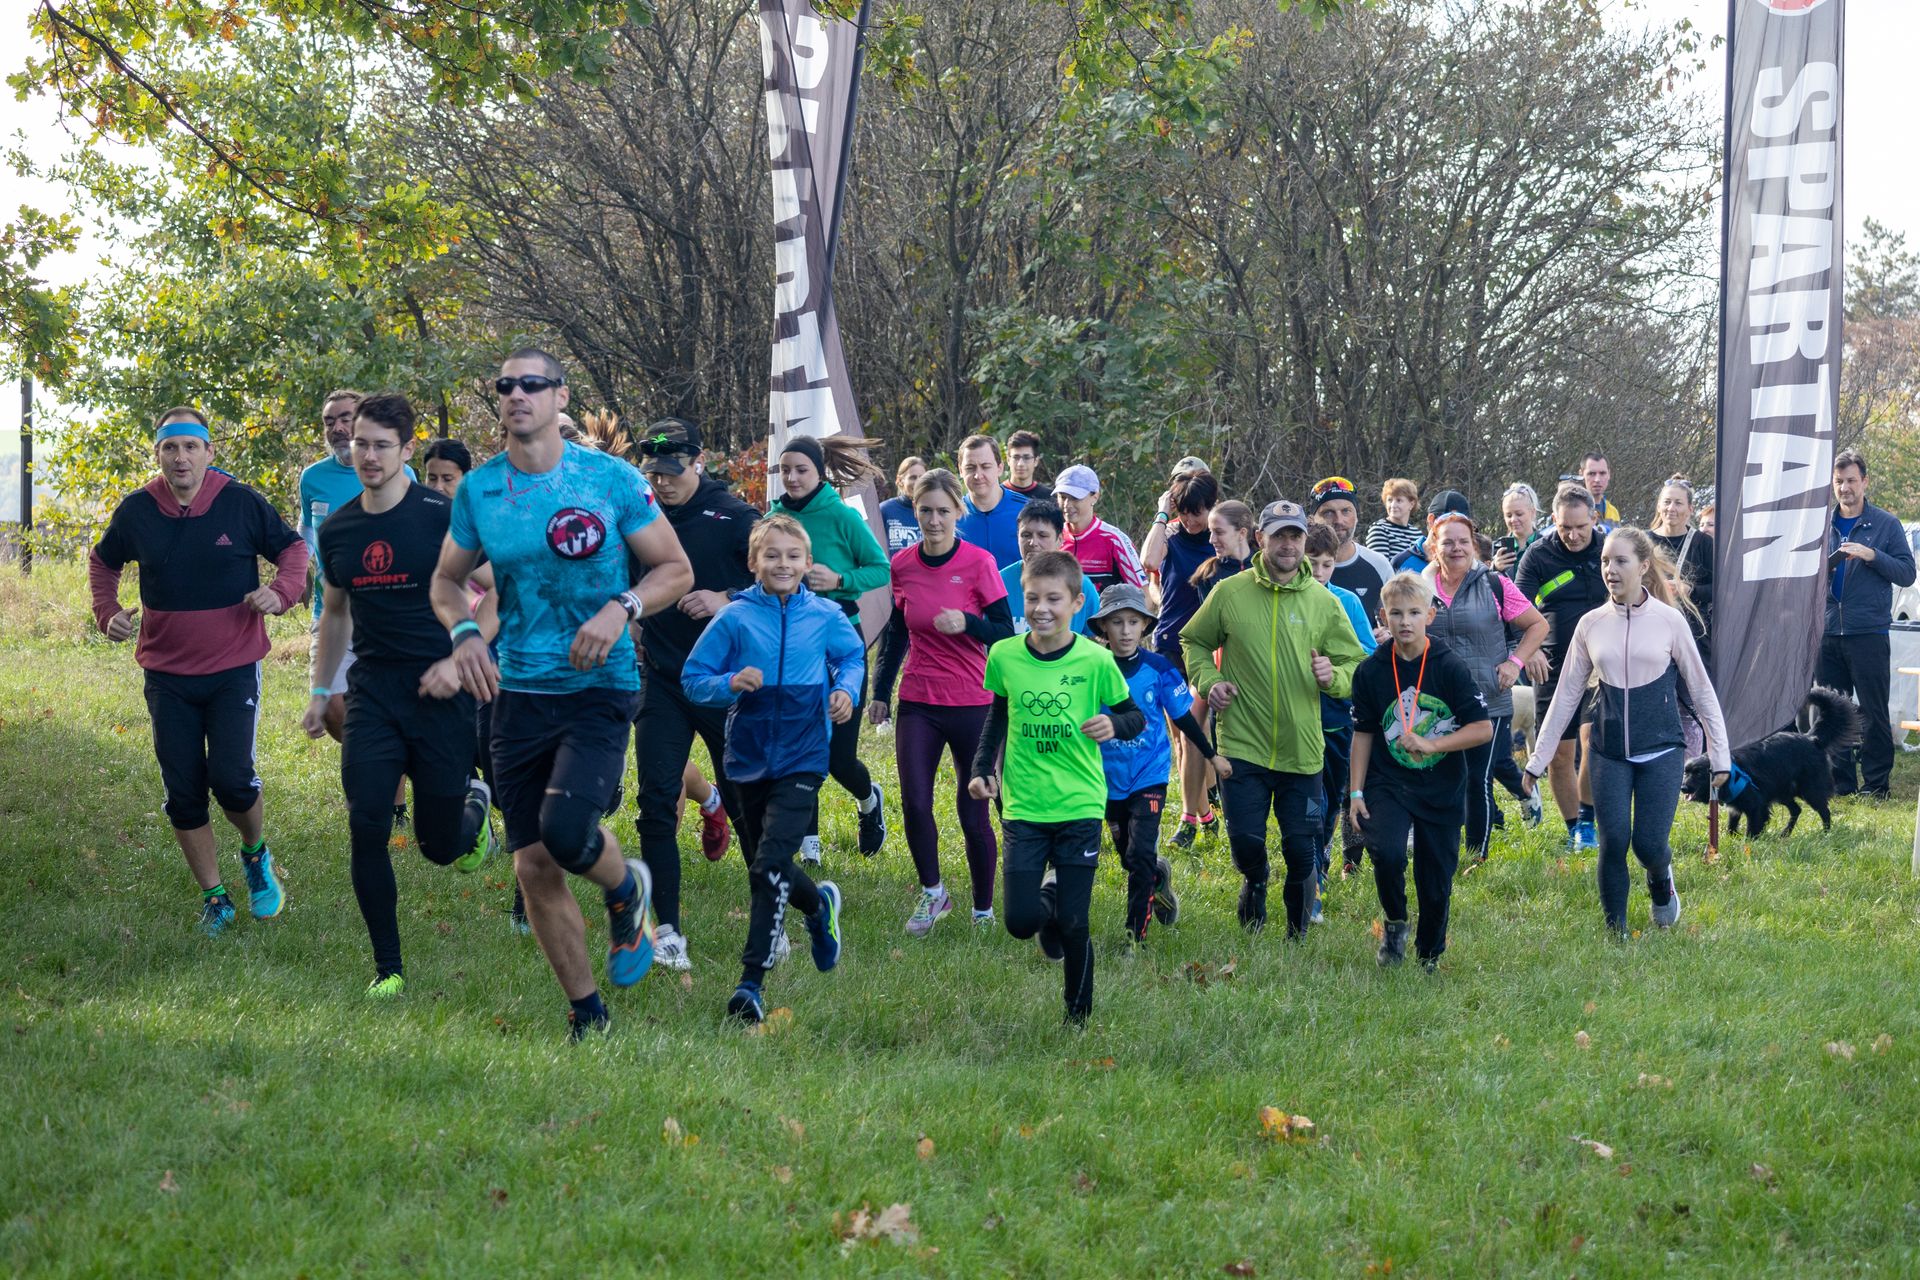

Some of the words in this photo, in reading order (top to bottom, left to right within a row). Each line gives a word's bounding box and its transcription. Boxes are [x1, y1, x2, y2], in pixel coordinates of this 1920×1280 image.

[1742, 61, 1837, 582] SPARTAN
[351, 573, 409, 587] SPRINT
[1022, 722, 1072, 739] OLYMPIC
[1036, 740, 1059, 754] DAY
[1149, 799, 1159, 814] 10
